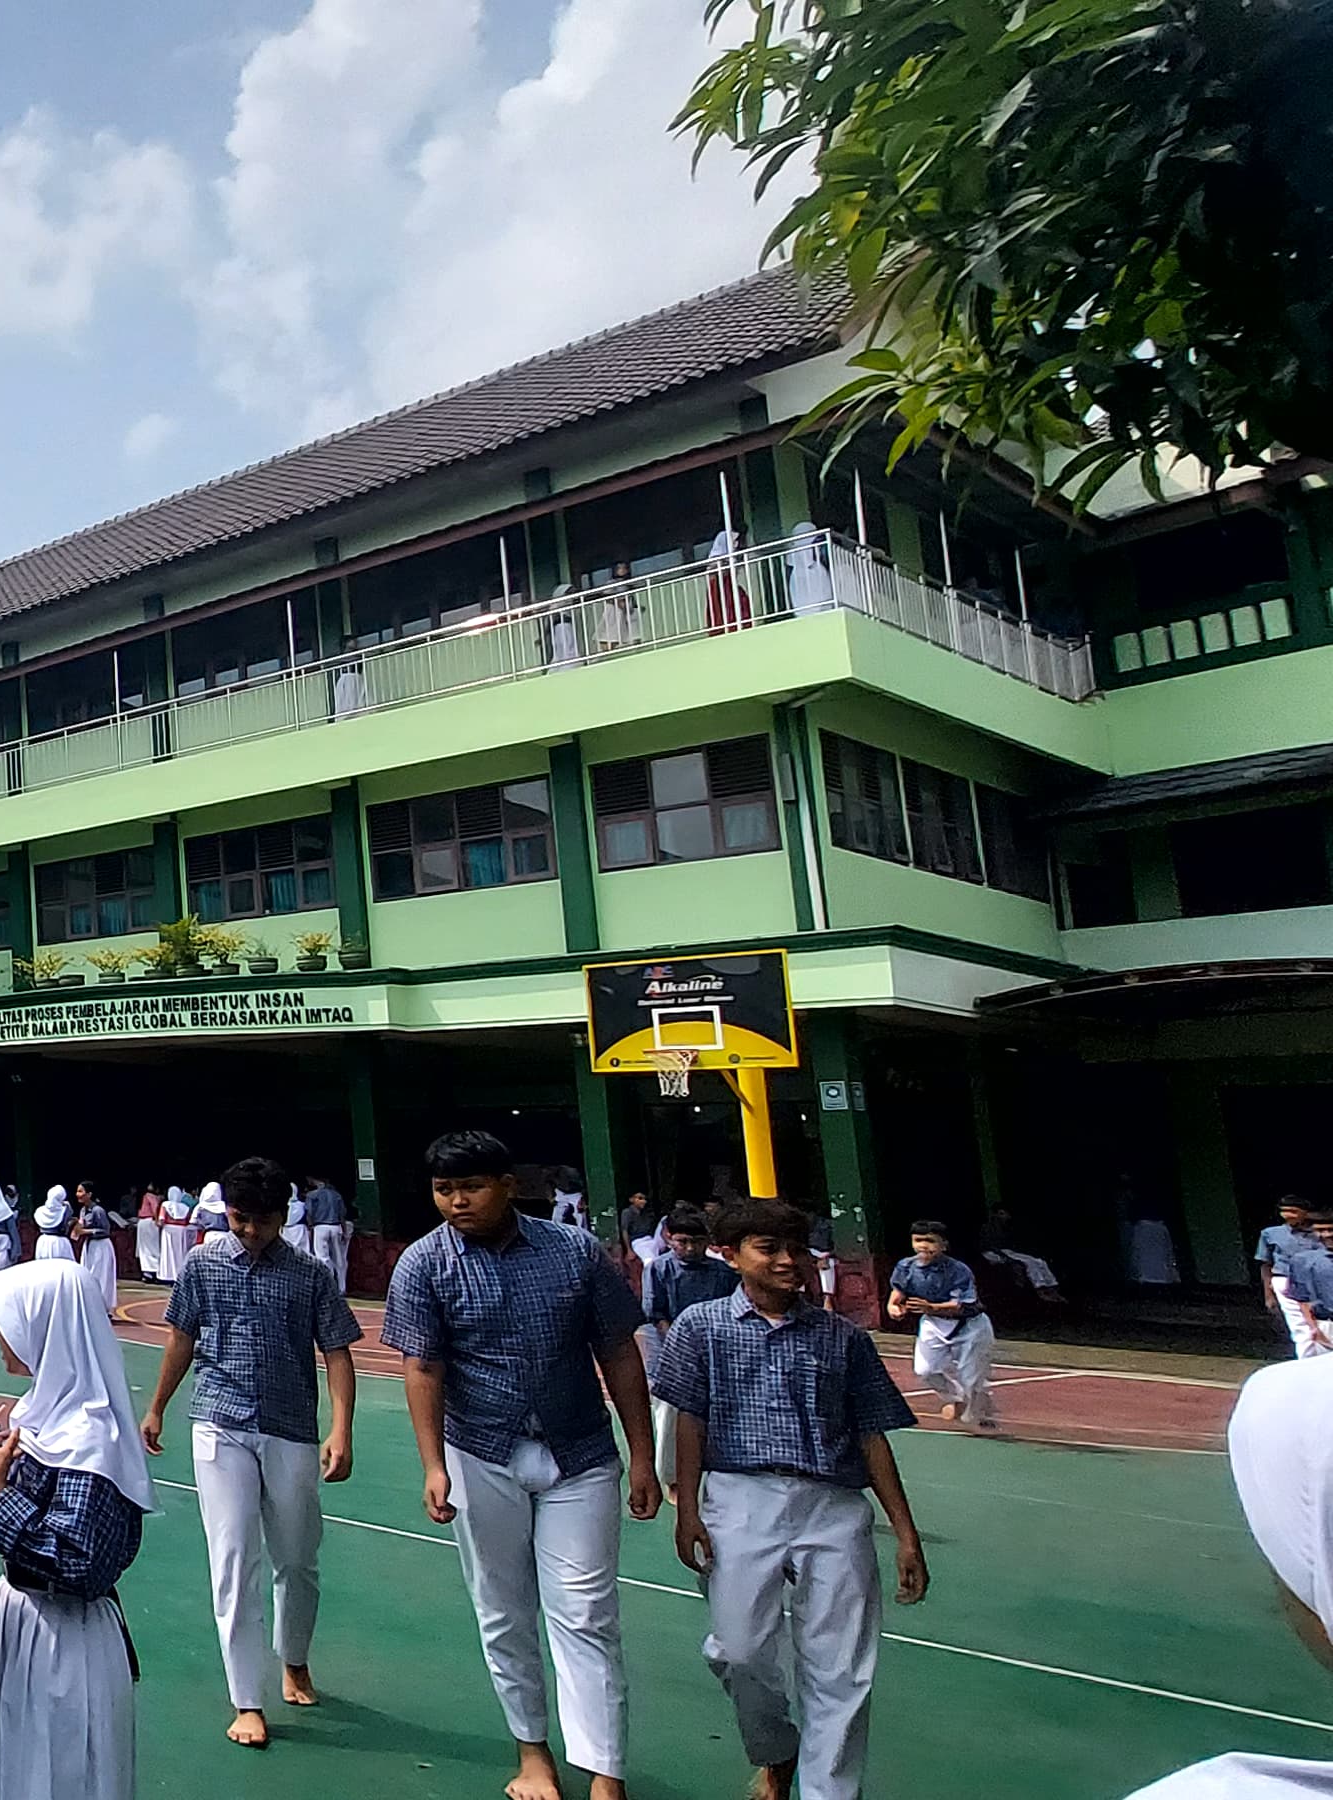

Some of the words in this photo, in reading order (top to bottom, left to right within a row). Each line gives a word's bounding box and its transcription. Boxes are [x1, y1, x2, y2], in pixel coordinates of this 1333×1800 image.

[644, 977, 724, 994] Alkaline
[24, 1006, 63, 1021] PROSES
[66, 998, 160, 1019] PEMBELAJARAN
[162, 993, 250, 1012] MEMBENTUK
[255, 992, 305, 1009] INSAN
[33, 1020, 69, 1037] DALAM
[70, 1016, 129, 1035] PRESTASI
[133, 1012, 187, 1030] GLOBAL
[190, 1009, 302, 1027] BERDASARKAN
[305, 1007, 354, 1024] IMTAQ
